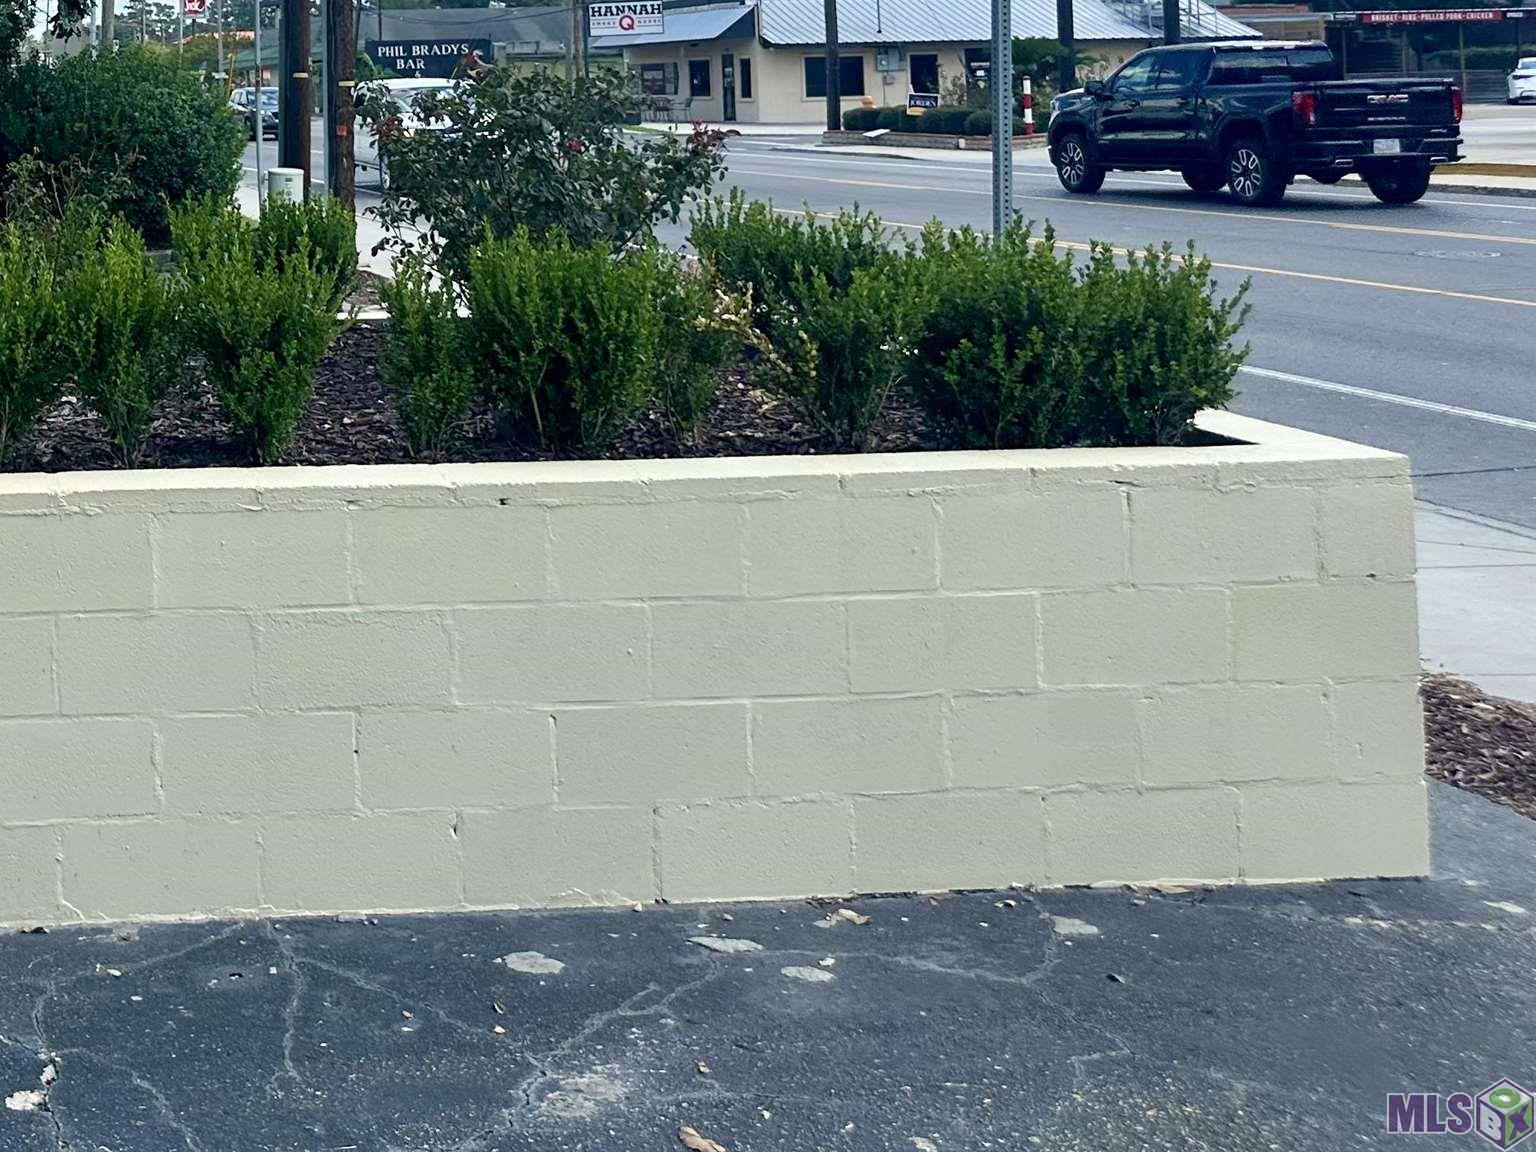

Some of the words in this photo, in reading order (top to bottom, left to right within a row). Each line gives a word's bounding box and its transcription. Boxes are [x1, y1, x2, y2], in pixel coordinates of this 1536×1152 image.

[590, 3, 662, 17] HANNAH
[619, 15, 634, 30] Q
[377, 46, 407, 57] PHIL
[412, 43, 469, 56] BRADYS
[396, 59, 425, 69] BAR
